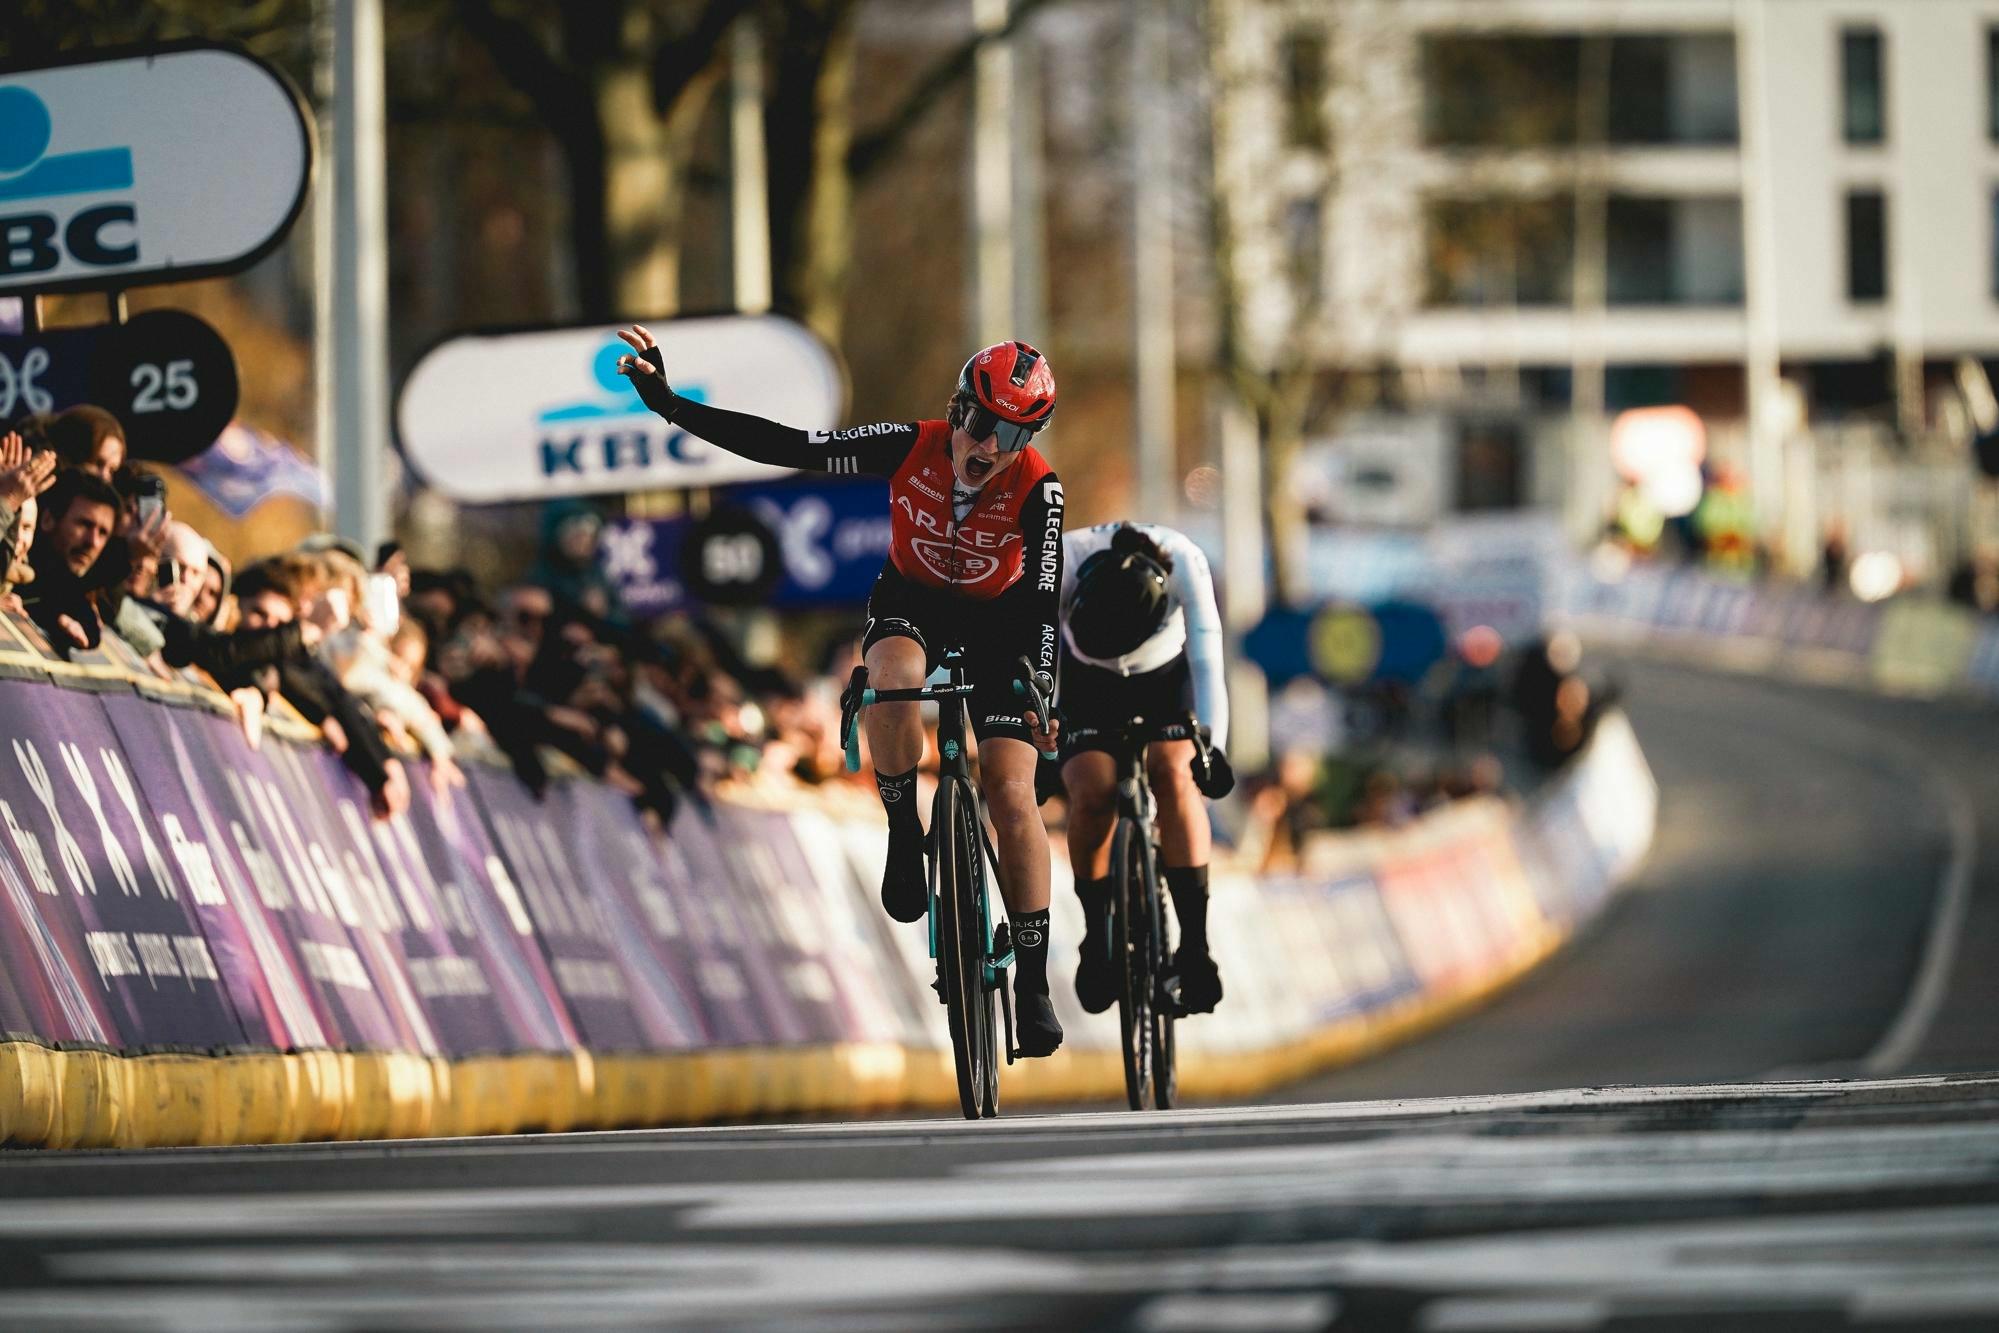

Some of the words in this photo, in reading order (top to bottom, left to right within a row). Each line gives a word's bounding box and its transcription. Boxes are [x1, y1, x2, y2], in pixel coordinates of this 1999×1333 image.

[130, 359, 199, 413] 25
[909, 475, 945, 501] Bianchi
[897, 495, 1022, 549] ARKEA
[1037, 507, 1062, 593] LEGENDRE
[1040, 622, 1055, 668] ARKEA
